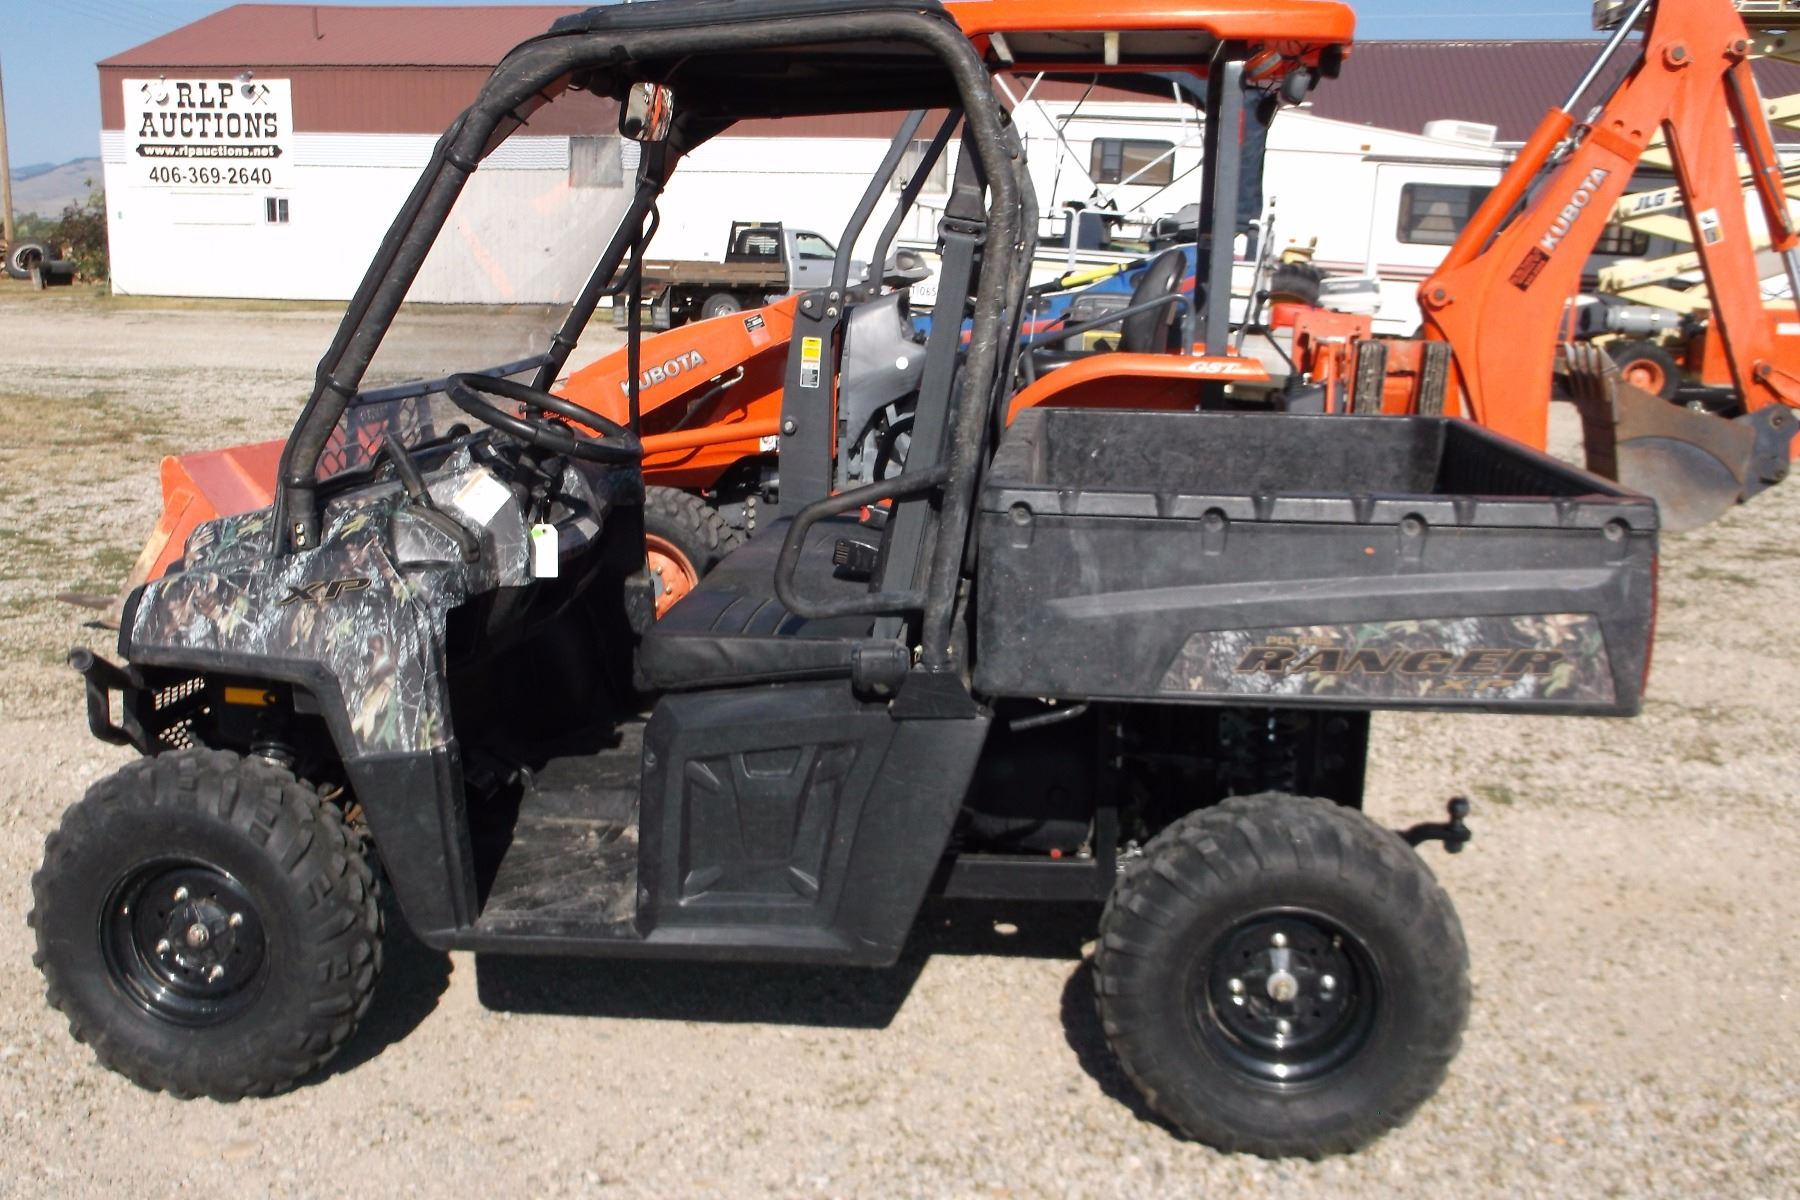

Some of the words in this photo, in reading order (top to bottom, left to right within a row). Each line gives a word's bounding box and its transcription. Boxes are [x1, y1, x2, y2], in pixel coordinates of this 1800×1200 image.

[176, 82, 233, 108] RLP
[139, 112, 278, 138] AUCTIONS
[143, 145, 275, 158] www.rlpauctions.net
[149, 166, 272, 184] 406-369-2640
[1539, 167, 1612, 250] KUBOTA
[1633, 192, 1667, 212] JLG
[276, 578, 372, 606] XP
[1233, 646, 1565, 676] RANGER
